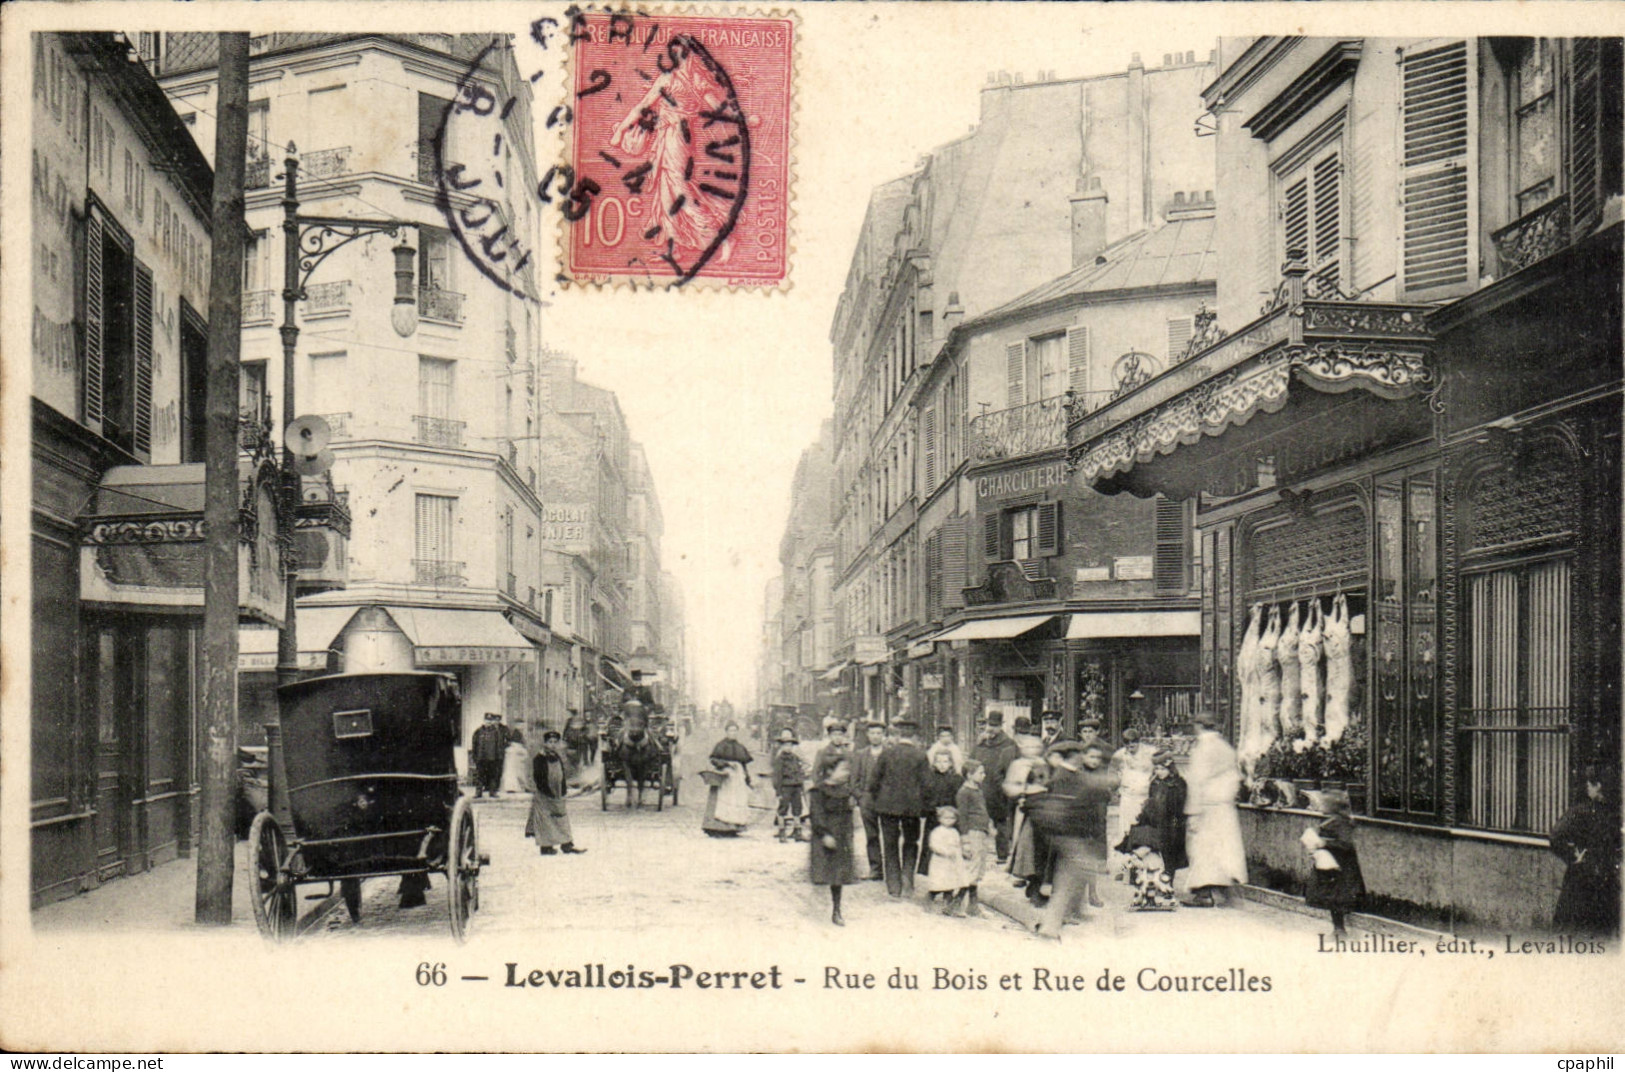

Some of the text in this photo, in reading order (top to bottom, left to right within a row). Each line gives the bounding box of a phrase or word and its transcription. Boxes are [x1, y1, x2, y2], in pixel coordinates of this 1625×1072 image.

[701, 28, 782, 48] FRANÇAISE
[757, 178, 778, 262] POSTES
[979, 462, 1068, 498] CHARCUTERIE
